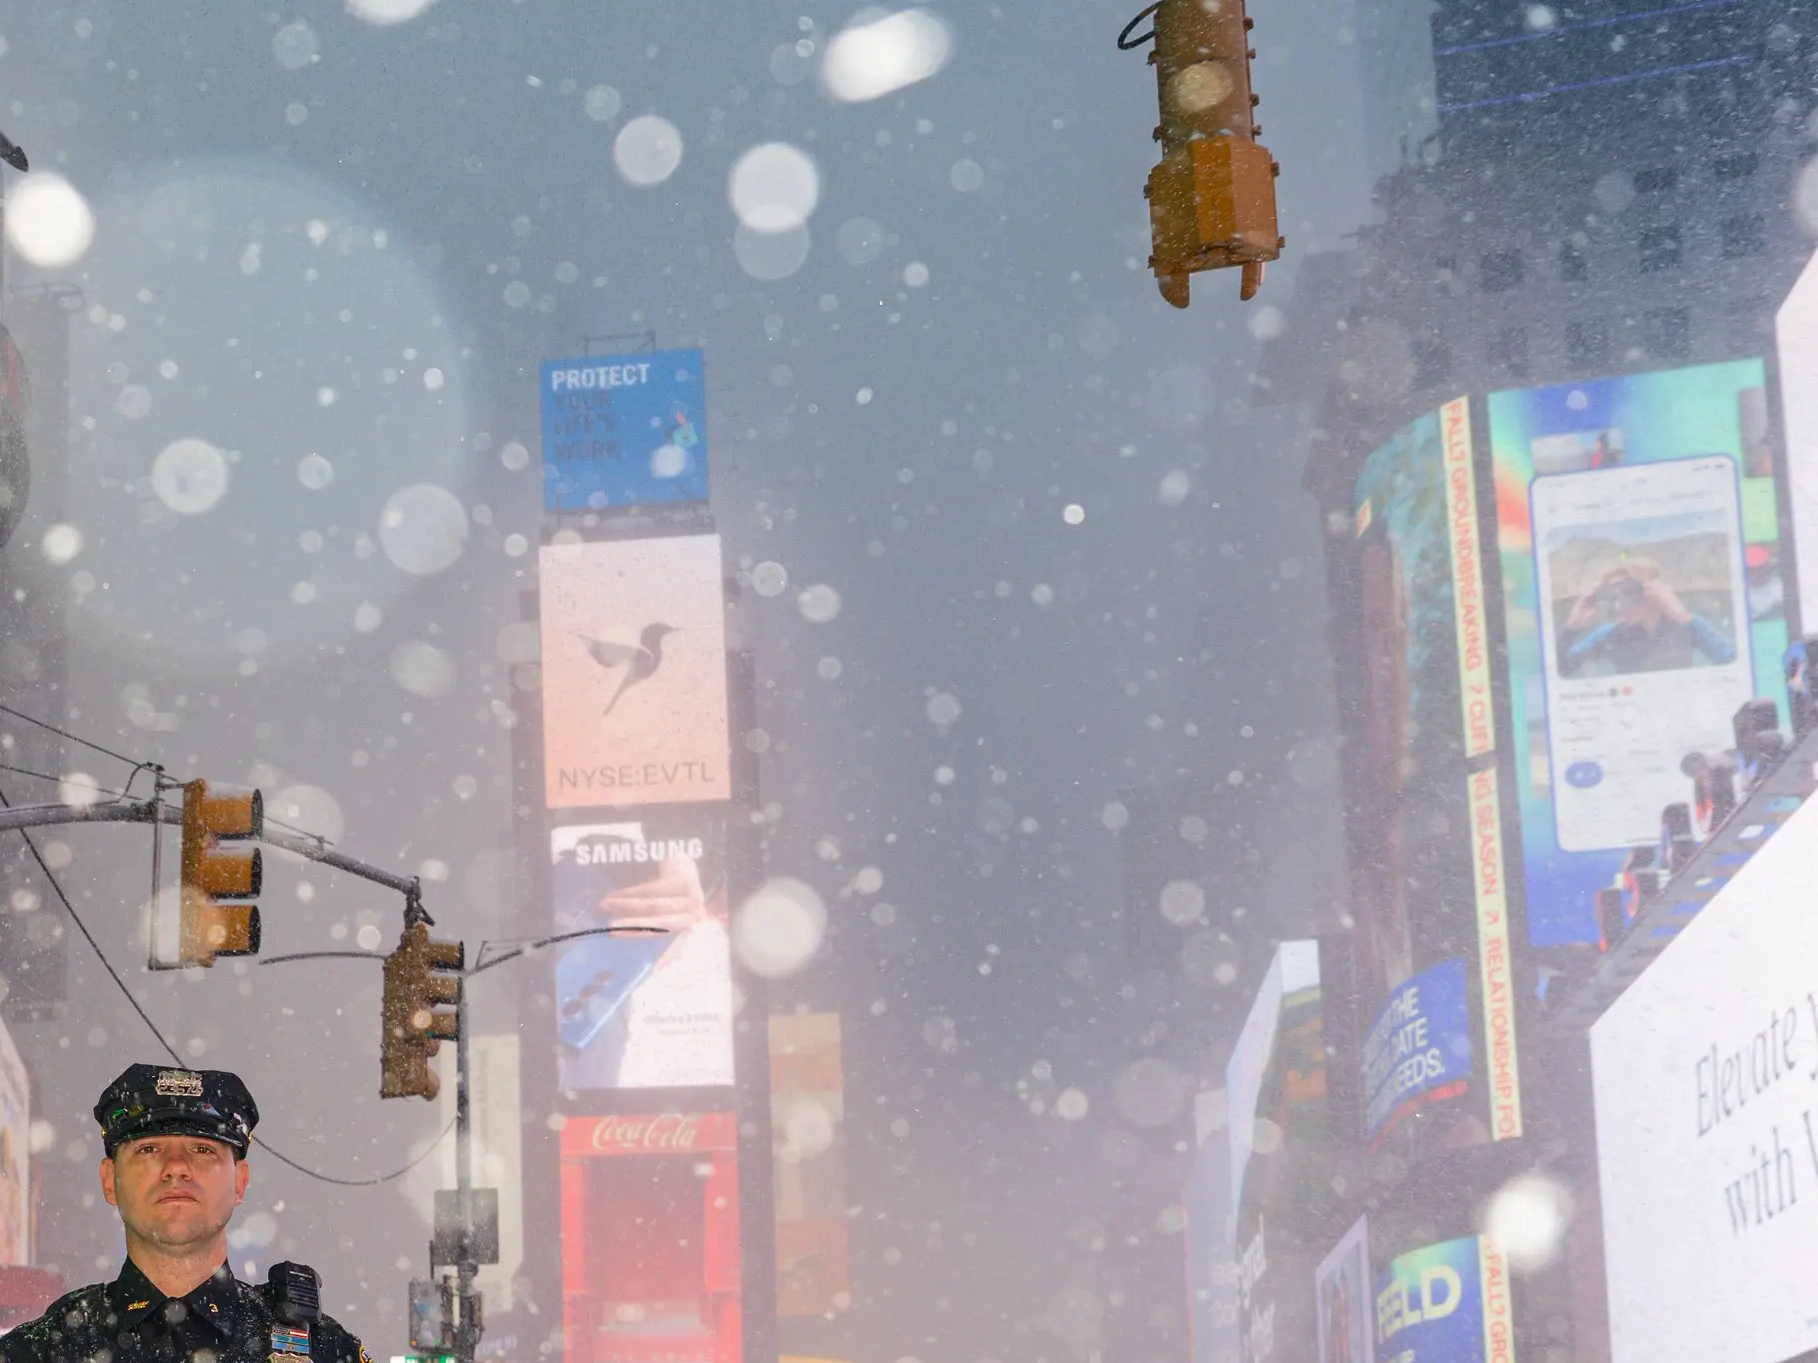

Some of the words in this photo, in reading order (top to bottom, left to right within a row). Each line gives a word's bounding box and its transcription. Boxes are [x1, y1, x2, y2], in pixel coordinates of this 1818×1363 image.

[552, 364, 650, 391] PROTECT
[1452, 467, 1482, 671] GROUNDBREAKING
[559, 761, 715, 790] NYSE:EVTL
[575, 838, 703, 866] SAMSUNG
[1475, 803, 1497, 896] SEASON
[1486, 936, 1512, 1099] RELATIONSHIP
[1695, 1004, 1797, 1138] Elevate
[592, 1112, 698, 1151] Coca-Cola
[1725, 1125, 1798, 1237] with
[1485, 1255, 1506, 1316] FALL?
